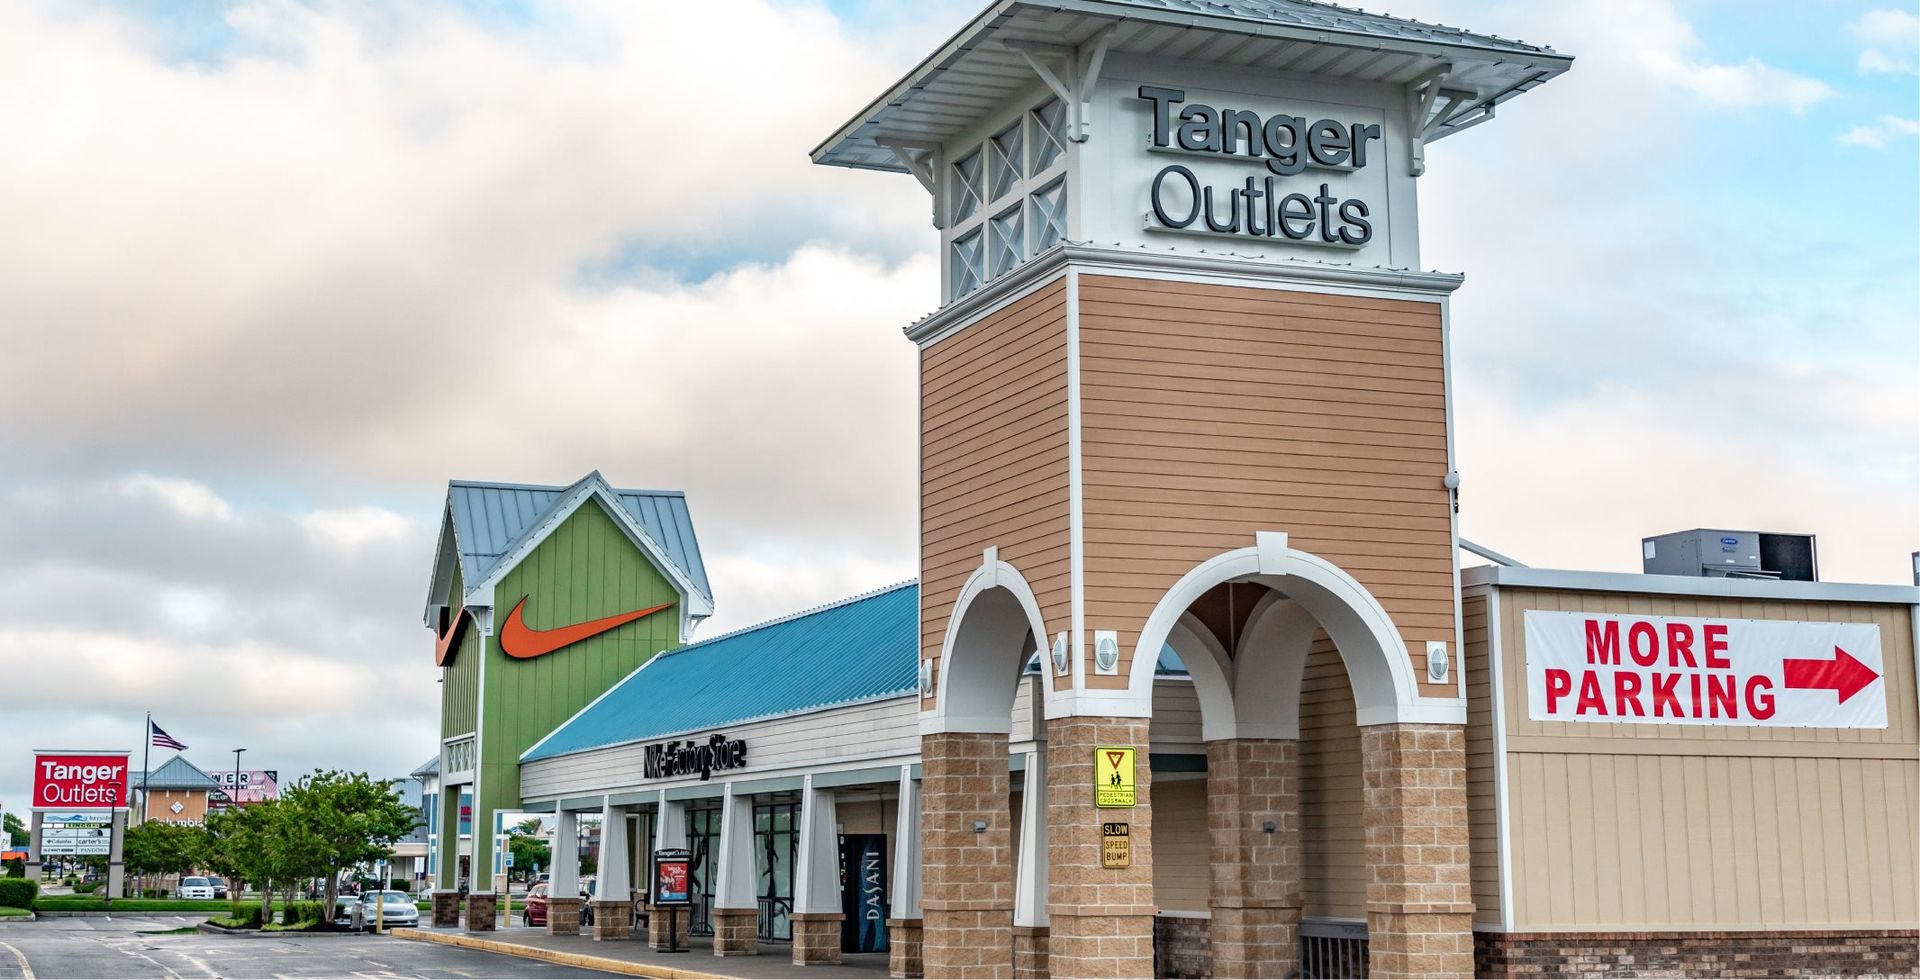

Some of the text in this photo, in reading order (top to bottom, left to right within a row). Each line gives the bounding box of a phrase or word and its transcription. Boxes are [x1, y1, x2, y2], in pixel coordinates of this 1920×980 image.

[1138, 85, 1381, 176] Tanger
[1151, 165, 1373, 245] Outlets
[1584, 619, 1731, 669] MORE
[1545, 668, 1776, 721] PARKING
[41, 761, 123, 784] Tanger
[644, 743, 667, 778] Nike
[708, 733, 746, 771] Store
[43, 783, 117, 803] Outlets
[1104, 825, 1128, 835] SLOW
[1105, 840, 1128, 850] SPEED
[1106, 852, 1128, 861] BUMP
[863, 851, 882, 920] DASANI
